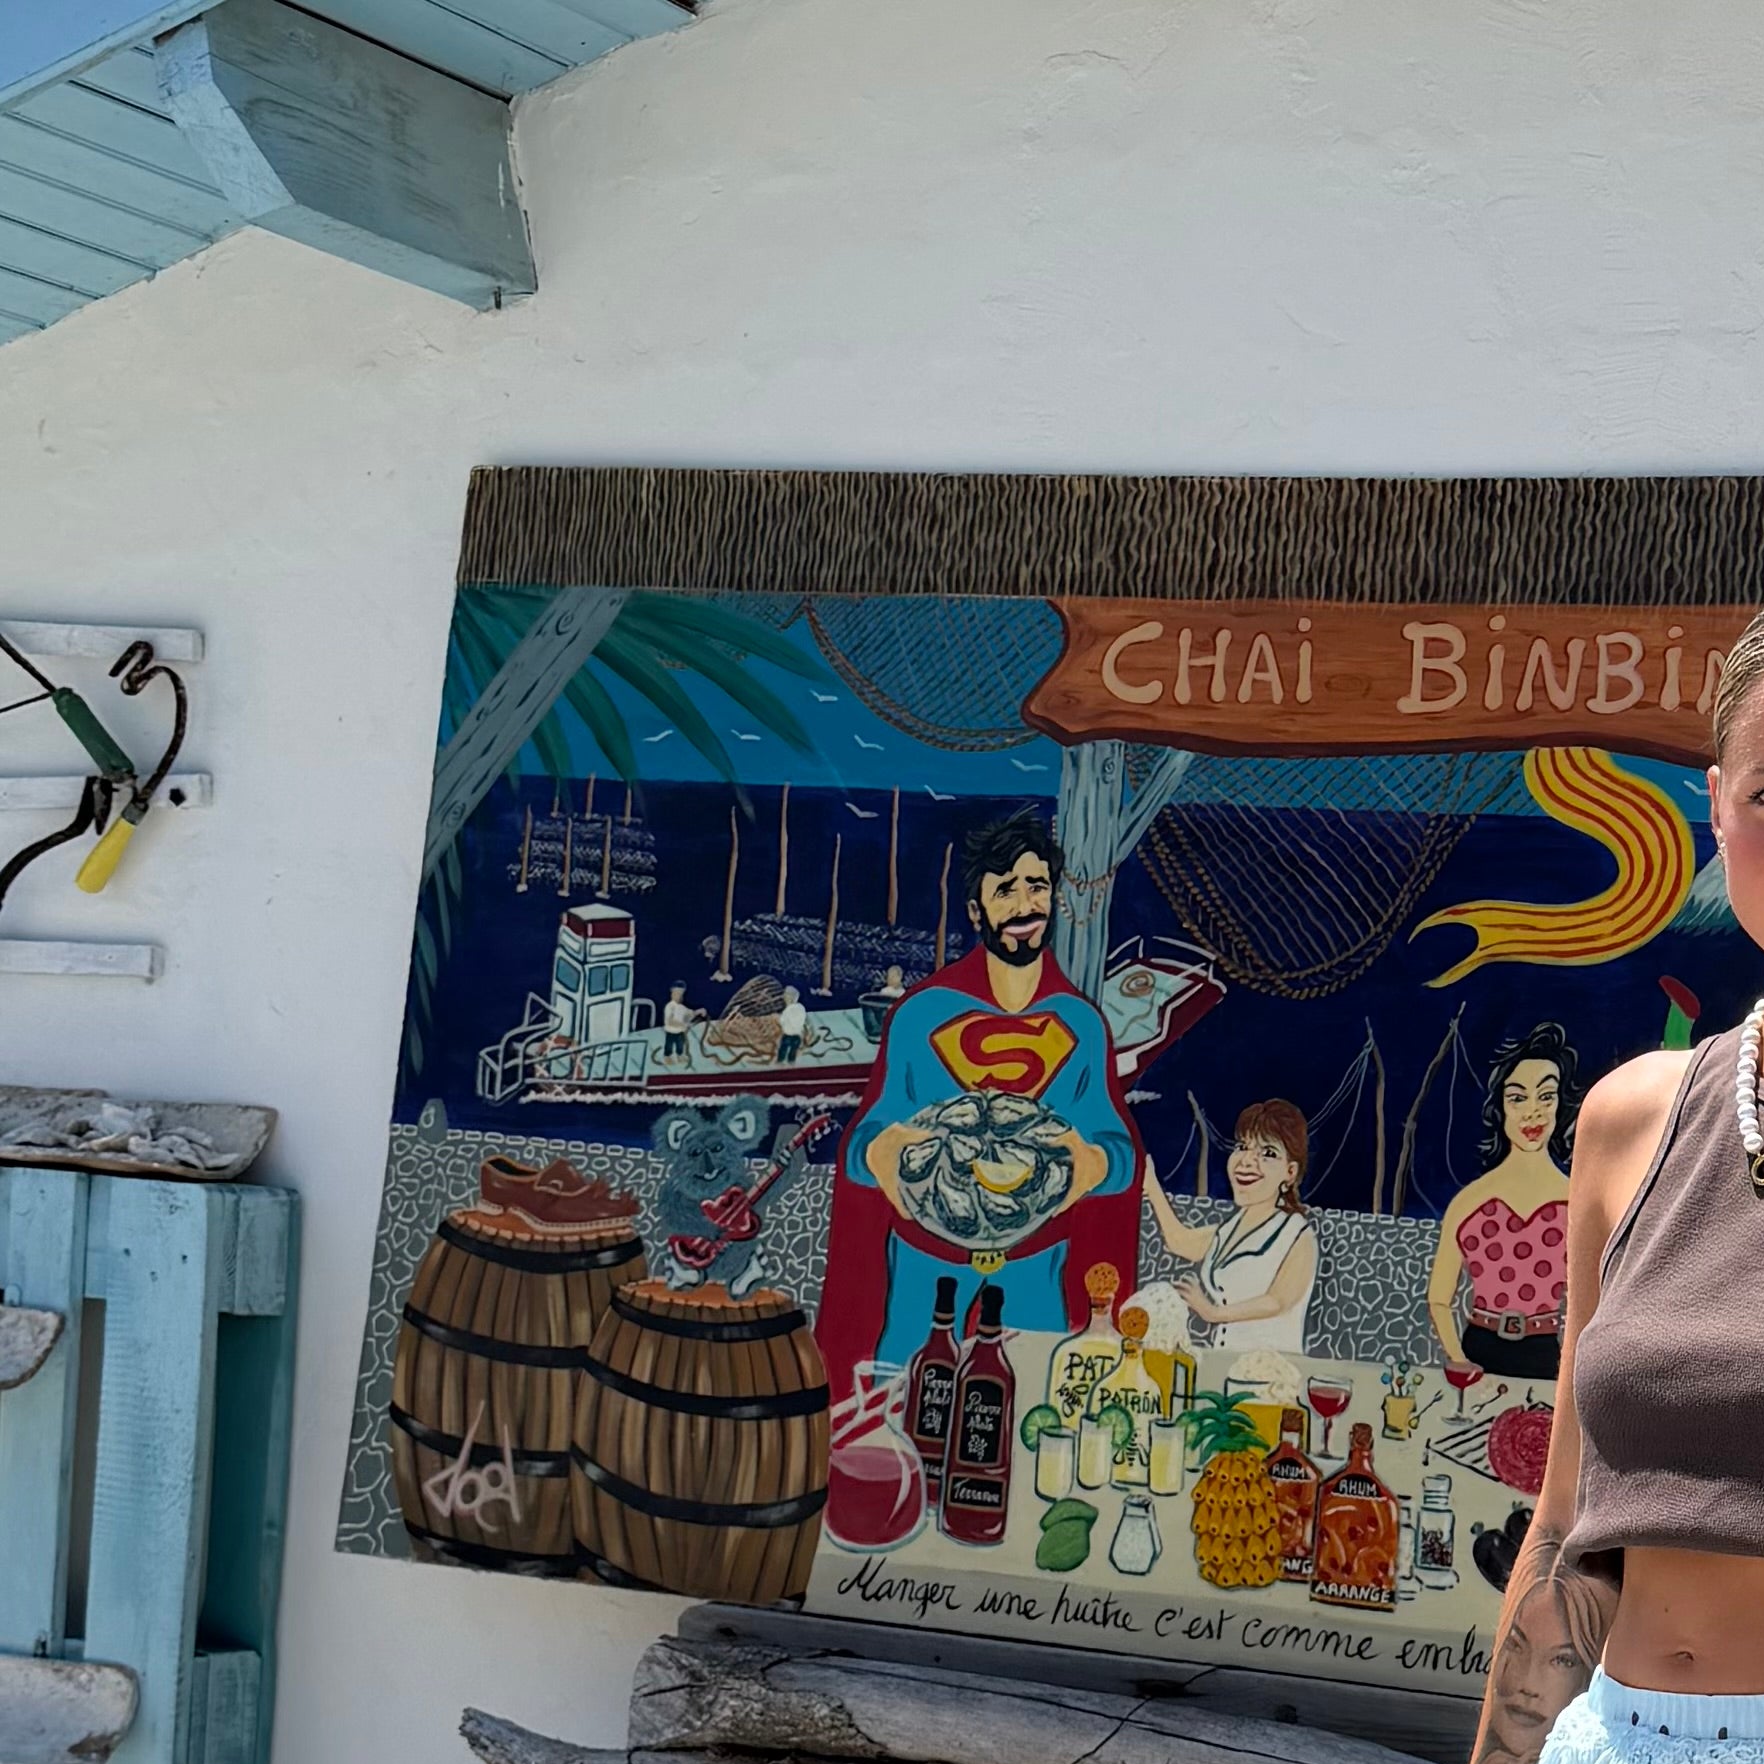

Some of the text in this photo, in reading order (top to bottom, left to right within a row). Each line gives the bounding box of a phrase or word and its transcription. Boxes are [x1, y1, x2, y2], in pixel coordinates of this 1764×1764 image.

[959, 1017, 1052, 1094] S
[1272, 1463, 1305, 1479] RHUM
[1338, 1479, 1377, 1497] RHUM
[837, 1556, 961, 1620] Manger
[974, 1587, 1046, 1621] une
